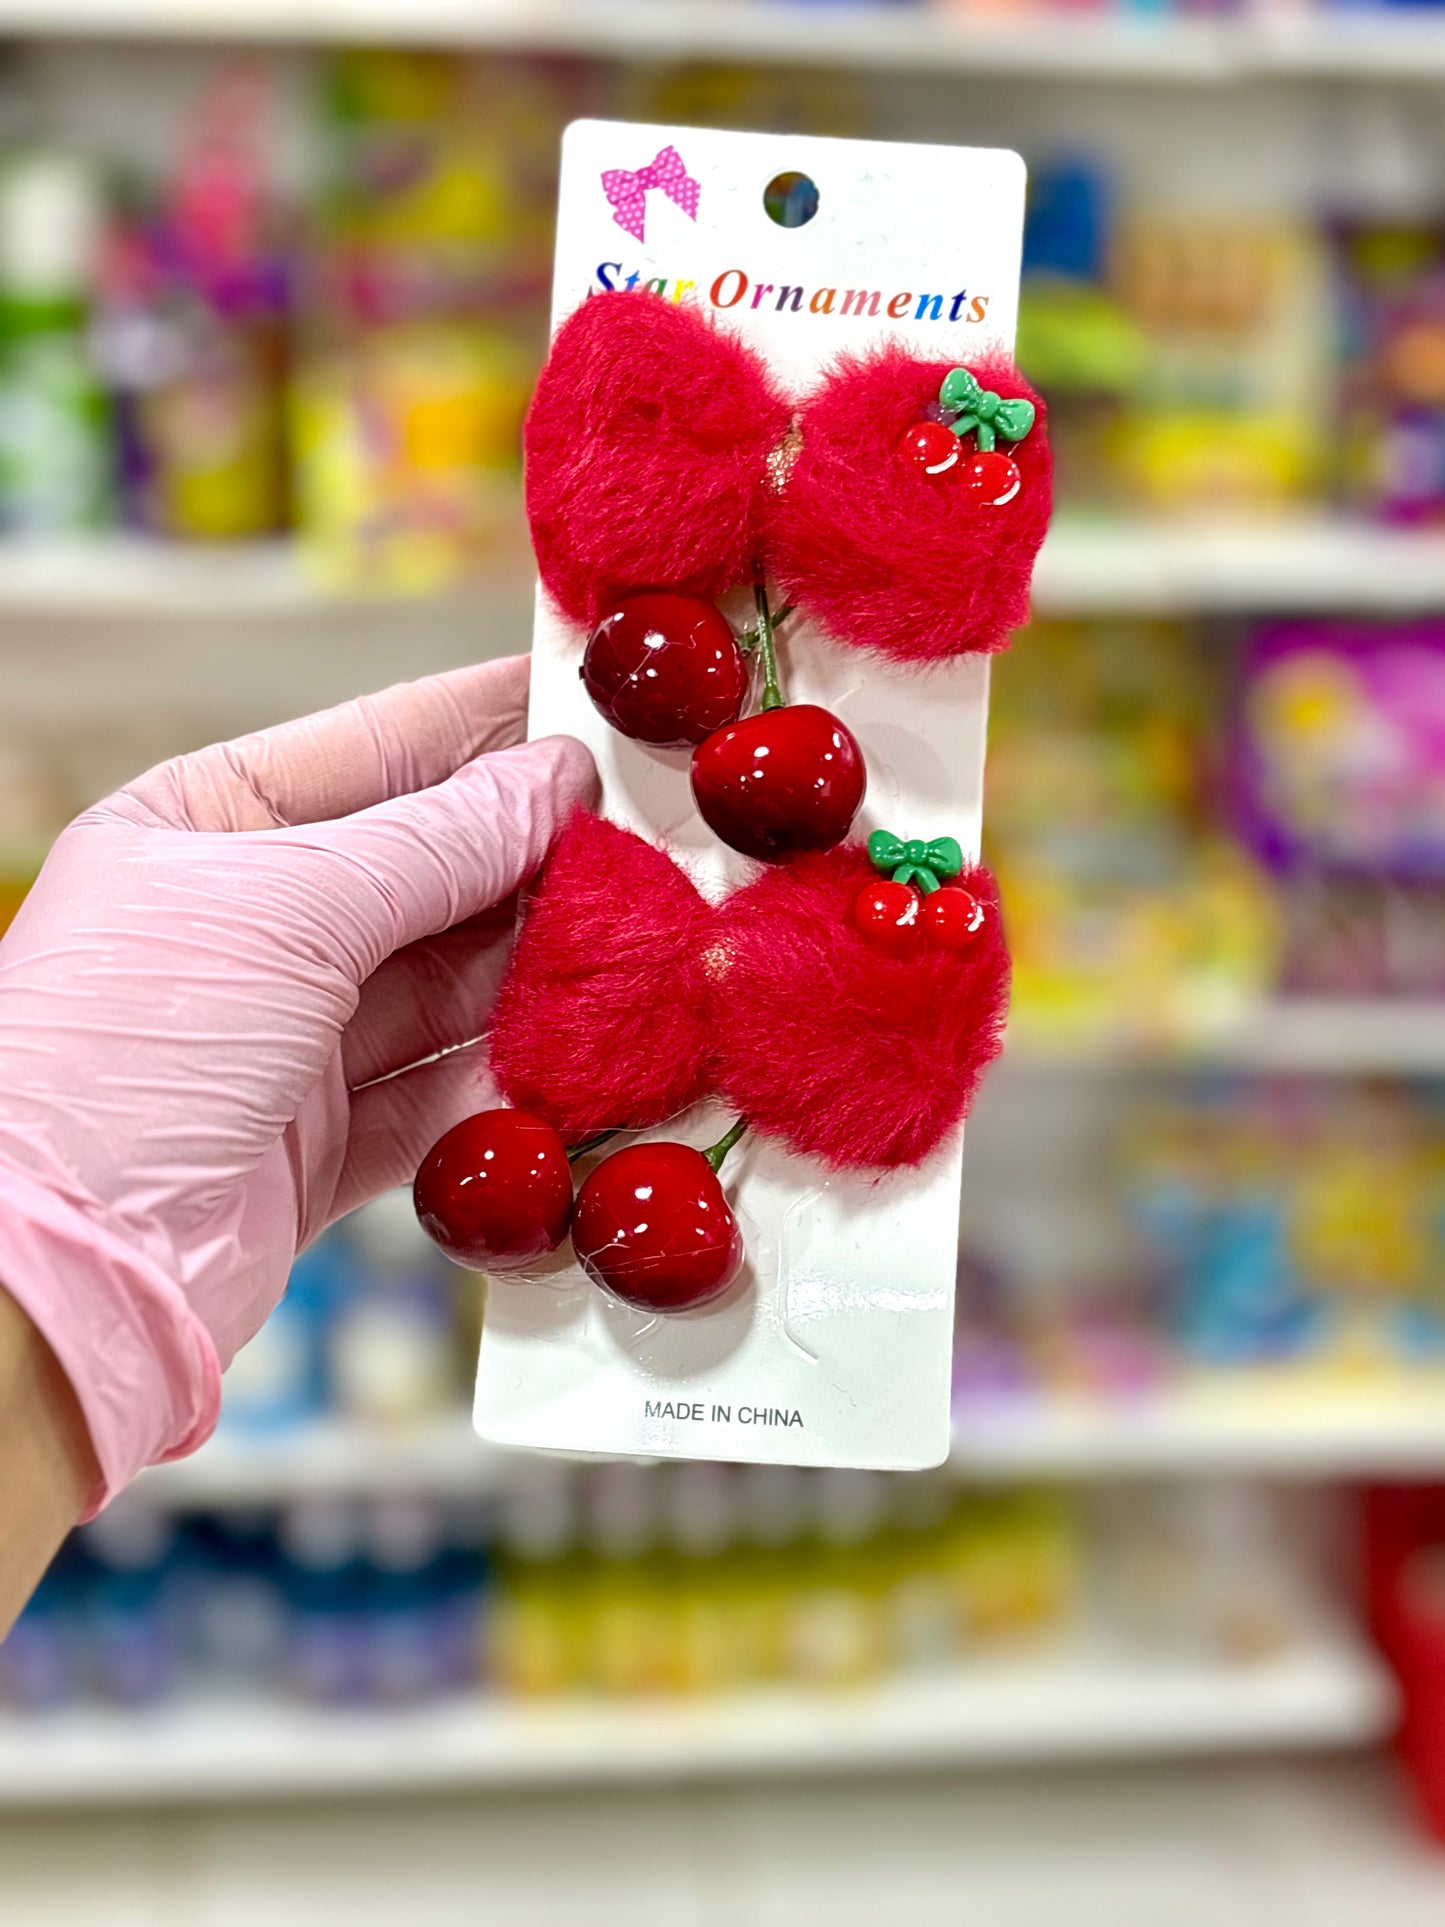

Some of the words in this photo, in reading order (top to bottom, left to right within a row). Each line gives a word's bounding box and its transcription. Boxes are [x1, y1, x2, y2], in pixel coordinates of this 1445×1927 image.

[709, 269, 989, 323] Ornaments
[644, 1400, 705, 1421] MADE
[711, 1404, 731, 1423] IN
[738, 1406, 804, 1428] CHINA
